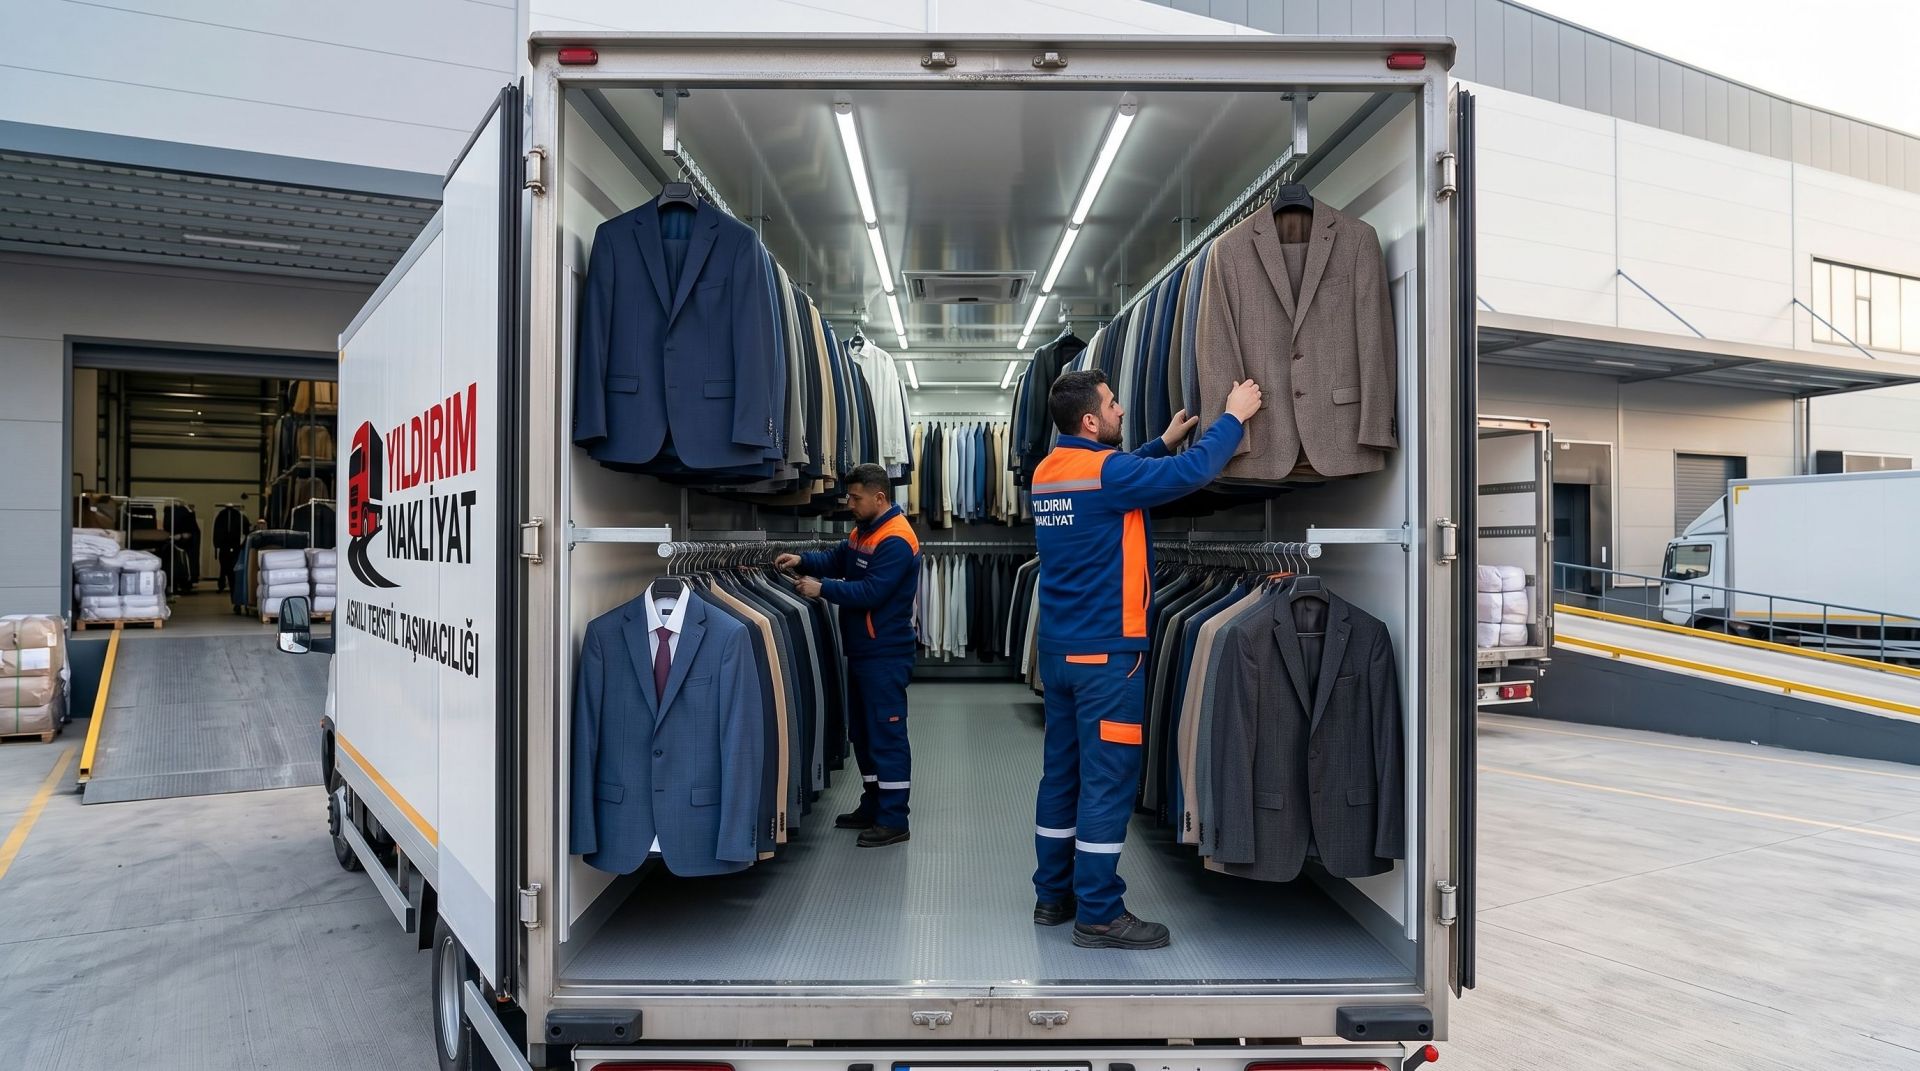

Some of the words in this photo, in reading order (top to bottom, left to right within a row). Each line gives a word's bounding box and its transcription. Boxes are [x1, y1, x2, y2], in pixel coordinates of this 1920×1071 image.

[386, 382, 477, 493] YILDIRIM
[387, 485, 476, 564] NAKLİYAT
[1032, 498, 1073, 512] YILDIRIM
[346, 598, 367, 632] ASKILI
[368, 602, 399, 645] TEKSTİL
[400, 617, 479, 679] TAŞIMACILIĞI
